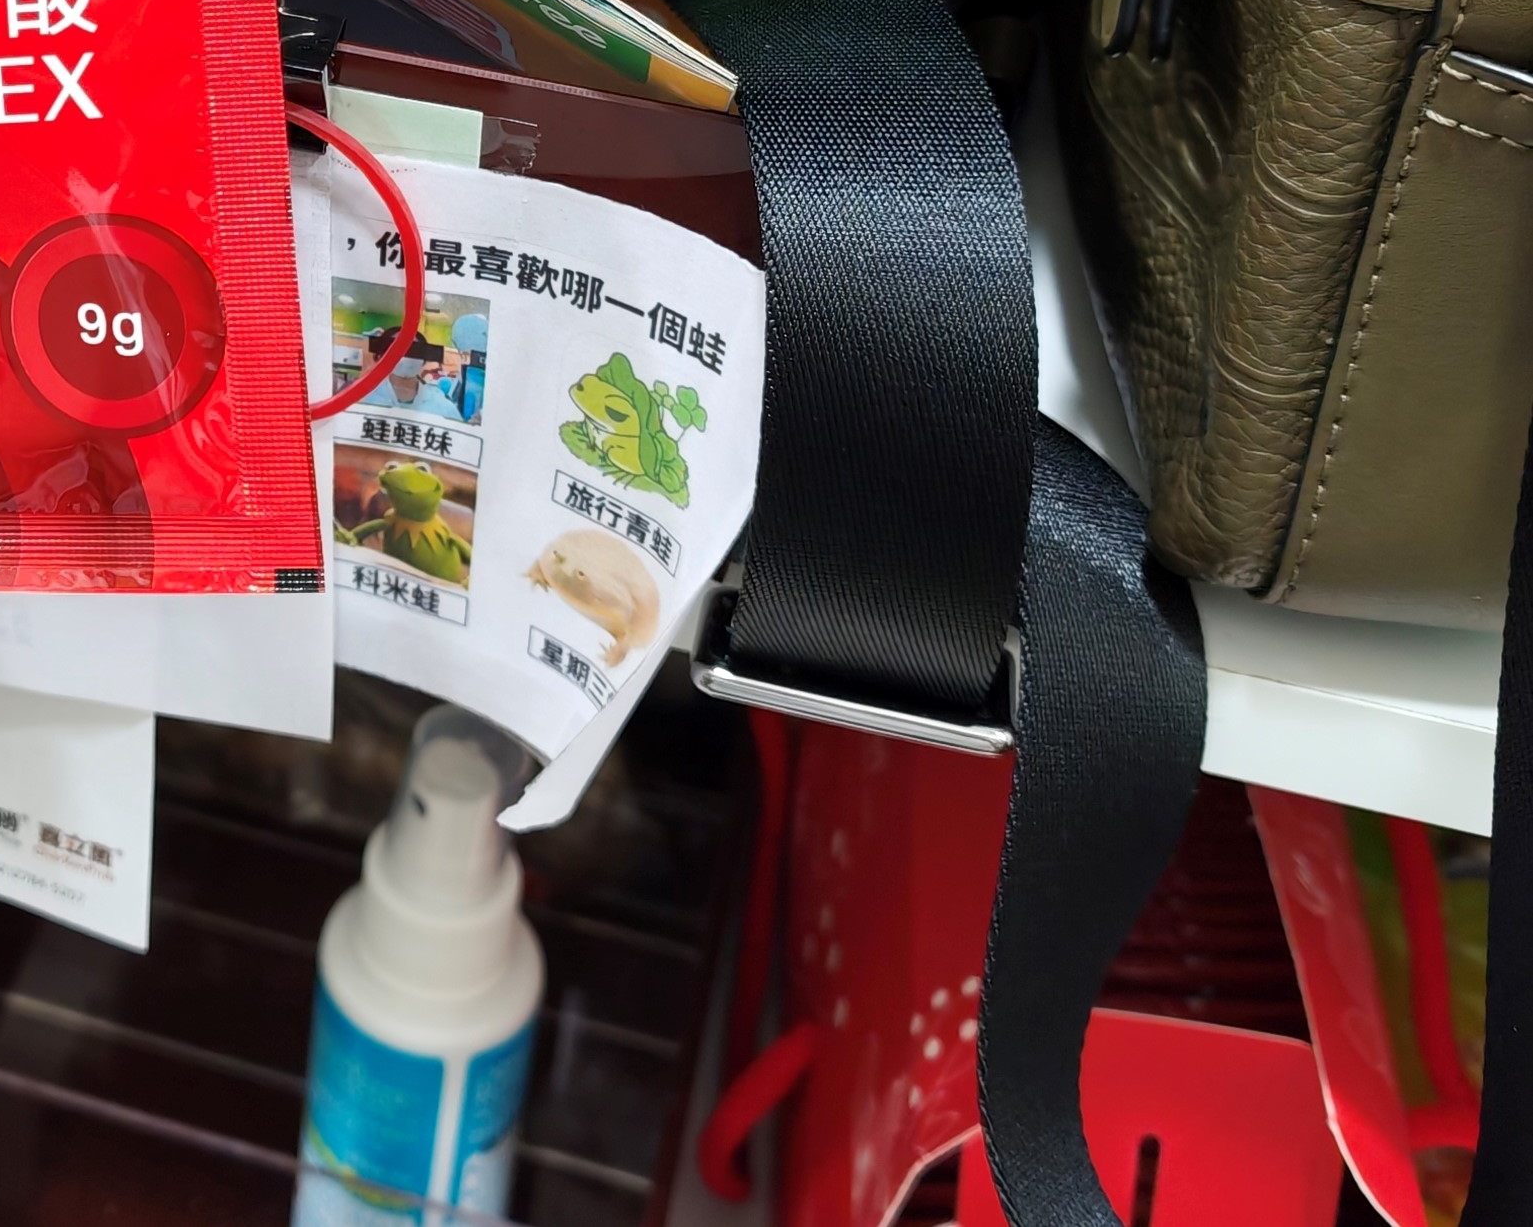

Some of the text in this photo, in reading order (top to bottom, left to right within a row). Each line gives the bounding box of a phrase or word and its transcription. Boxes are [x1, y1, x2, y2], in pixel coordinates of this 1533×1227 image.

[76, 302, 145, 357] 9g
[360, 417, 453, 457] 蛙蛙妹
[563, 480, 674, 567] 旅行青蛙
[351, 565, 441, 616] 科米蛙
[539, 637, 614, 710] 星期三
